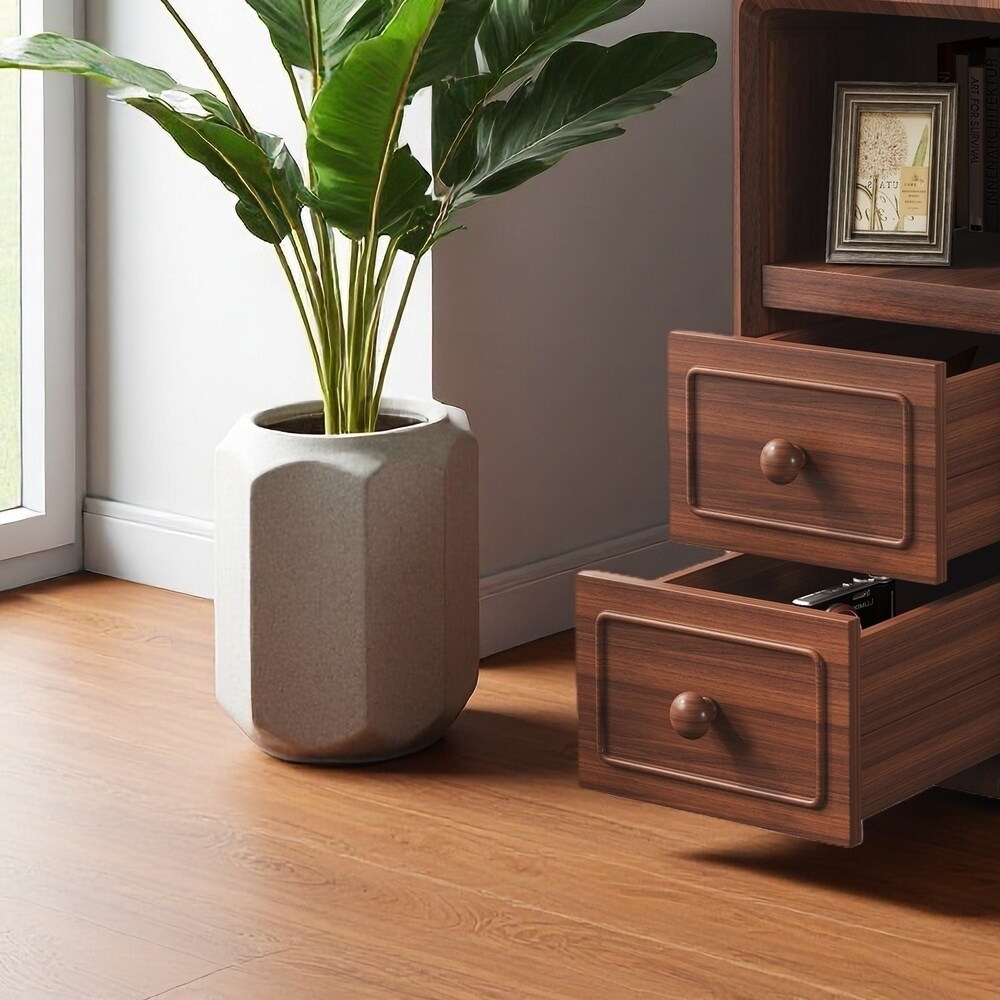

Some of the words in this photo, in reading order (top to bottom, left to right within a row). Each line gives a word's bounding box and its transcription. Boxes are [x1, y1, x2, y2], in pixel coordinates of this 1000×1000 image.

[970, 76, 980, 95] ART
[970, 97, 980, 118] FOR
[970, 121, 980, 163] SURVIVAL
[985, 57, 998, 206] INNENARCHITEKTUR
